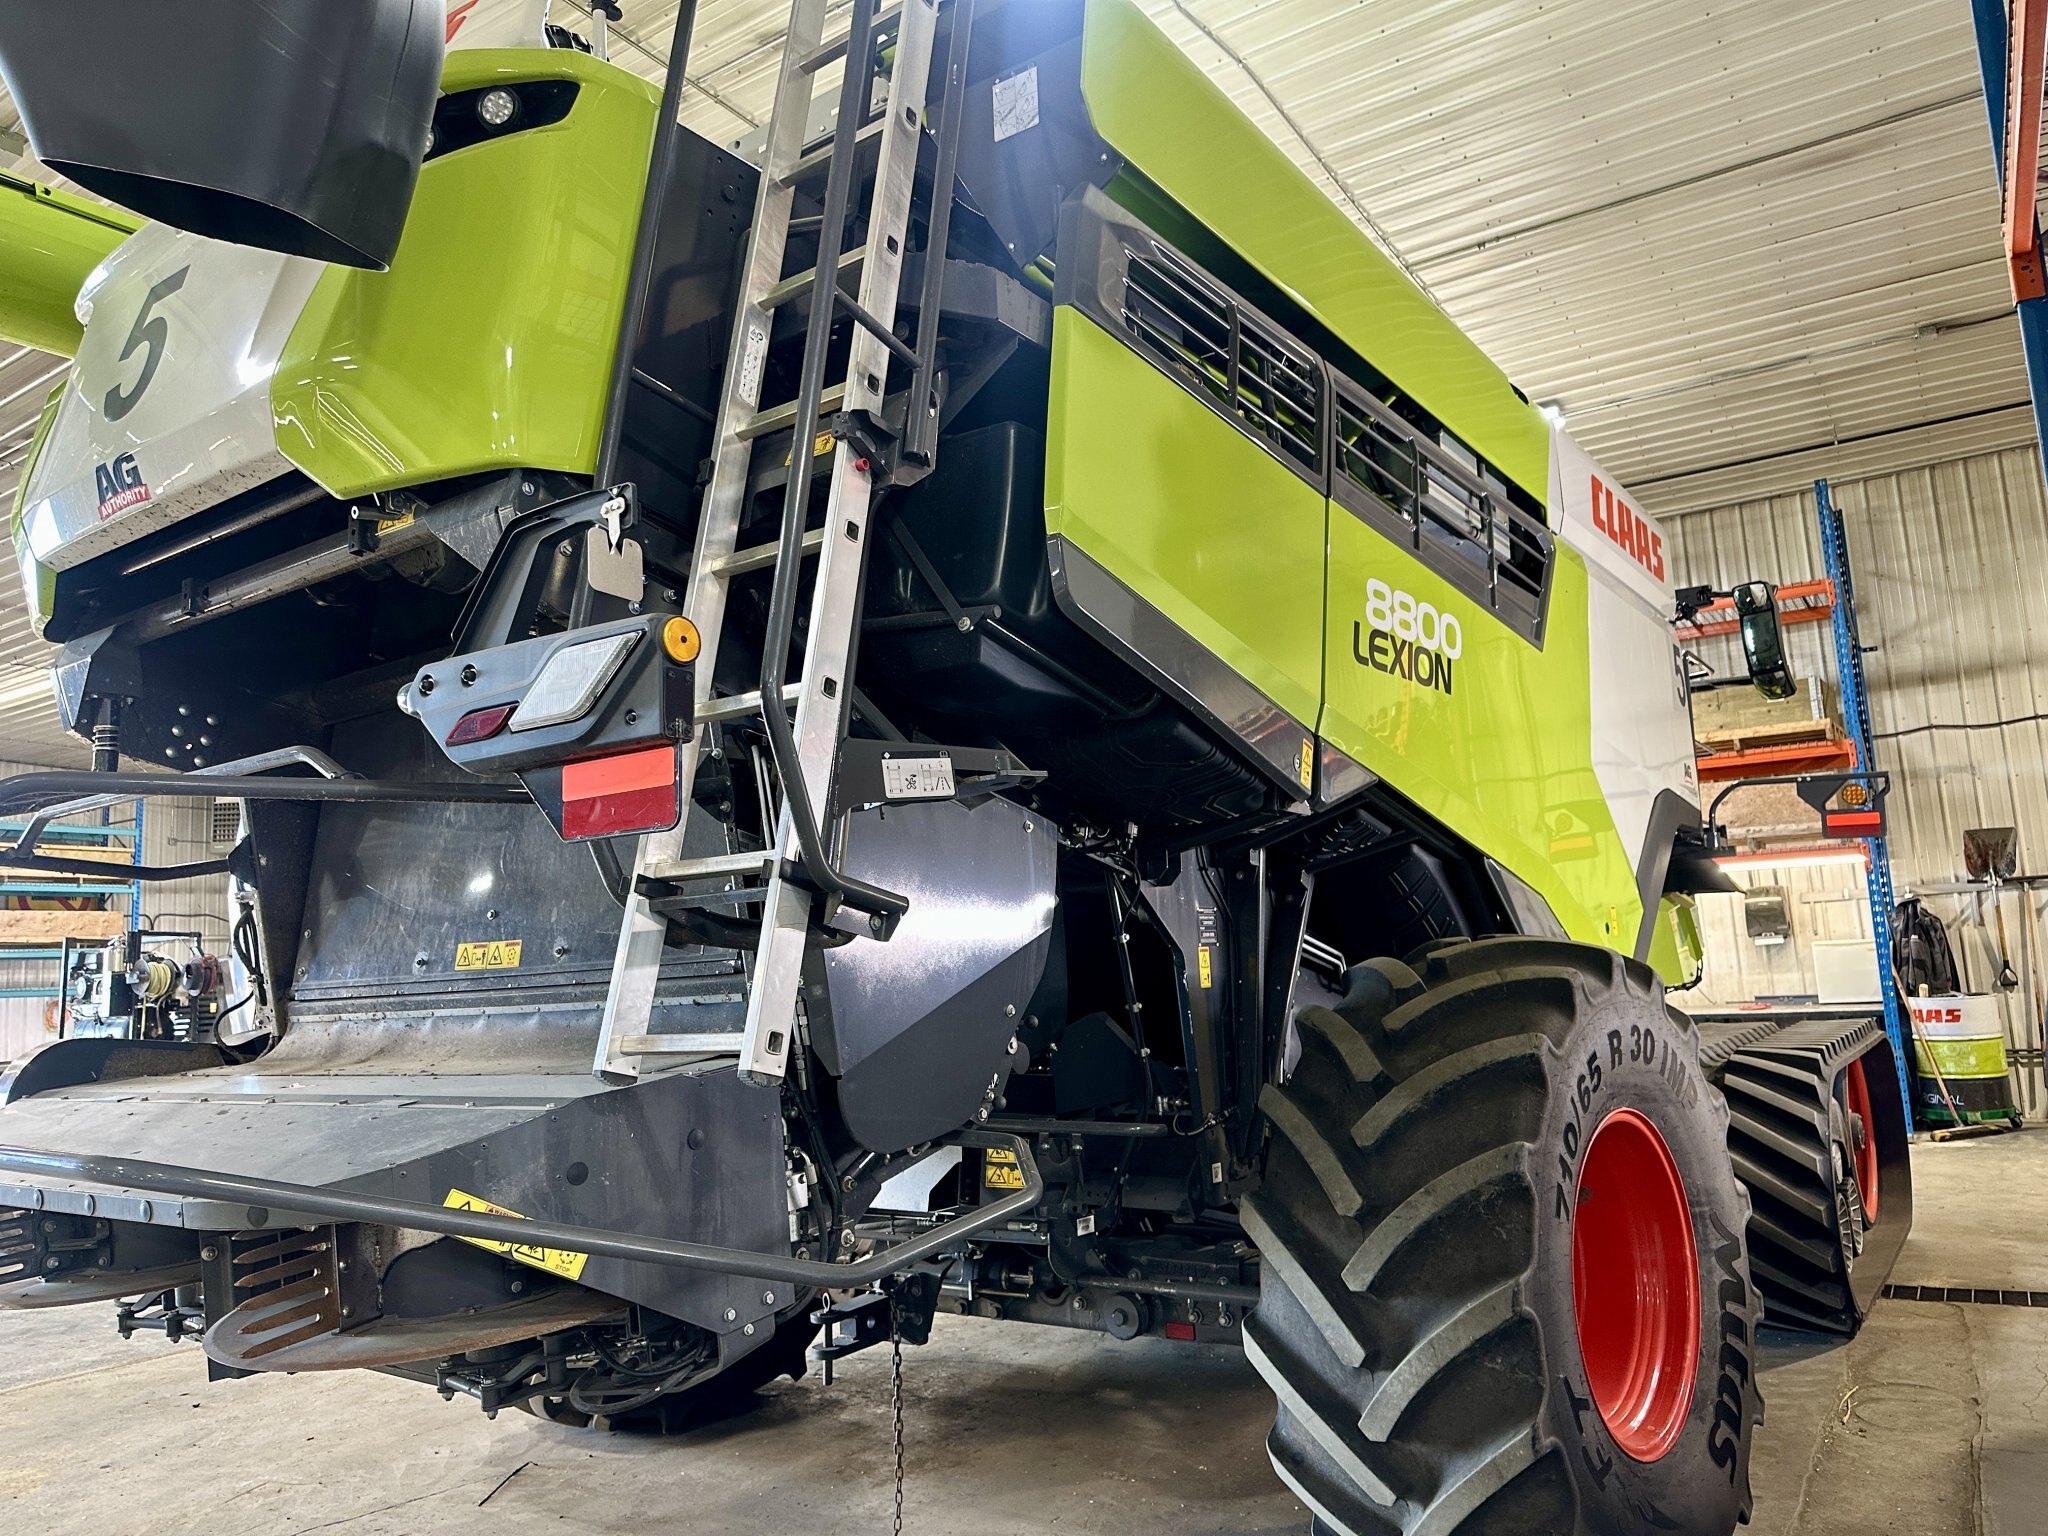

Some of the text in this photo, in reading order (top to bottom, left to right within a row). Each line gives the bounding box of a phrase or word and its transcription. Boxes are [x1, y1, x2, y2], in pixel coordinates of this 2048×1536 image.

[104, 264, 191, 422] 5
[96, 452, 143, 506] AG
[101, 486, 147, 518] AUTHORITY
[1591, 474, 1665, 583] CLAAS
[1366, 578, 1462, 660] 8800
[1353, 620, 1452, 695] LEXION
[1673, 643, 1686, 707] 5
[1911, 1008, 1962, 1023] AAS
[1554, 1050, 1602, 1224] 710/65
[1607, 1029, 1623, 1071] R
[1630, 1024, 1656, 1065] 30
[1926, 1093, 1965, 1105] GINAL
[555, 1263, 571, 1273] STOP
